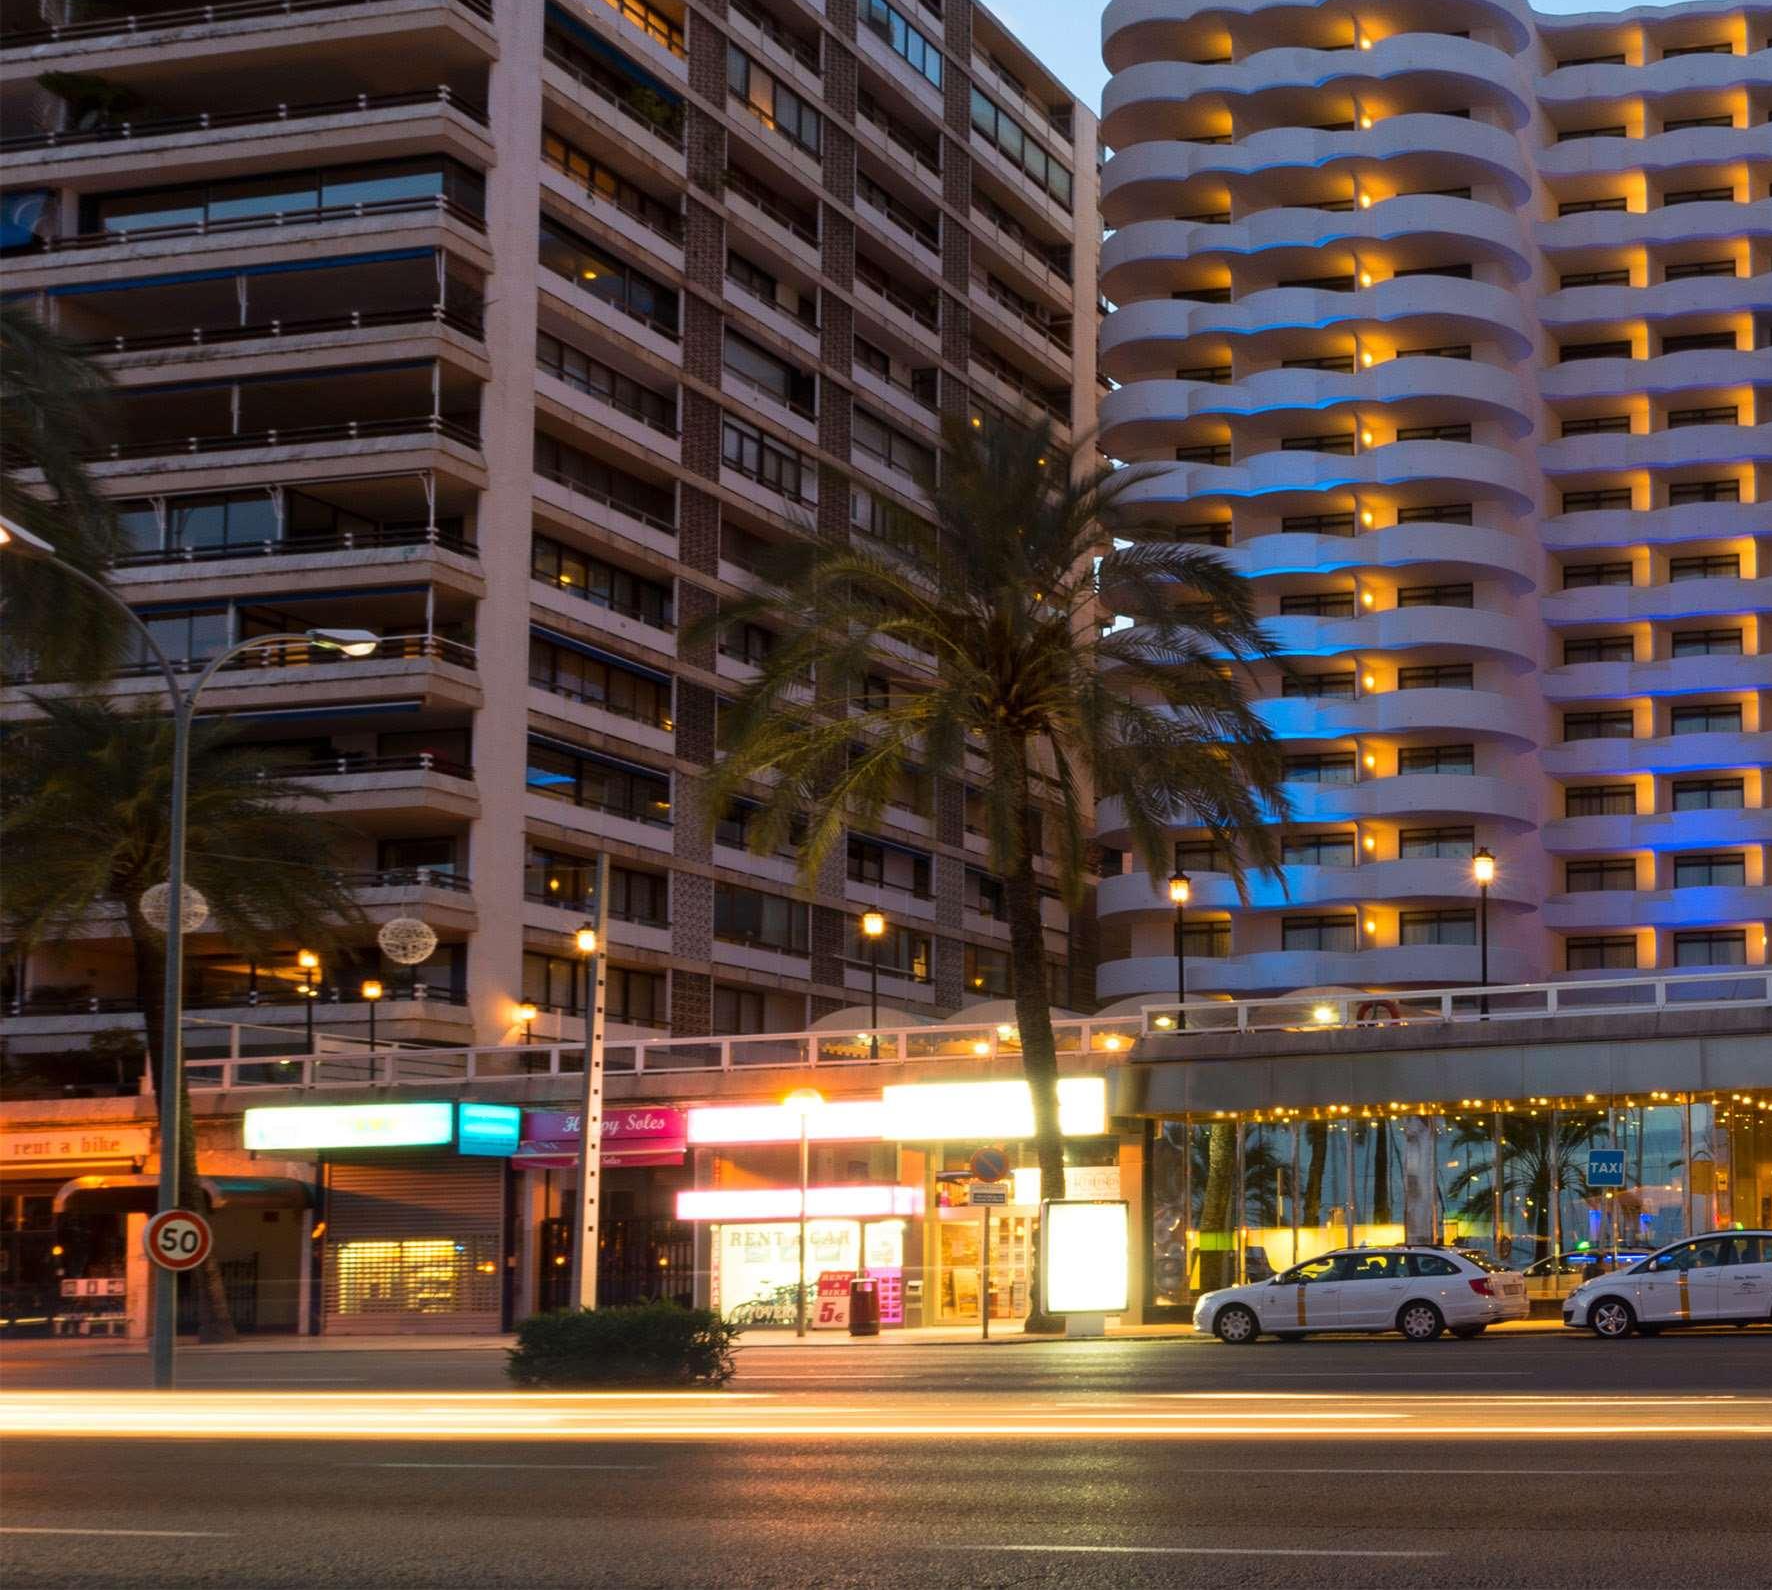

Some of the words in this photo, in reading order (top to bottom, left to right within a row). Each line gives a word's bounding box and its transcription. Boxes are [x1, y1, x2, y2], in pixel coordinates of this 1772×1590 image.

[626, 1114, 665, 1130] Soles
[14, 1142, 50, 1155] rent
[60, 1142, 71, 1154] a
[81, 1136, 121, 1153] bike
[1590, 1162, 1623, 1174] TAXI
[161, 1227, 198, 1254] 50
[728, 1231, 784, 1247] RENT
